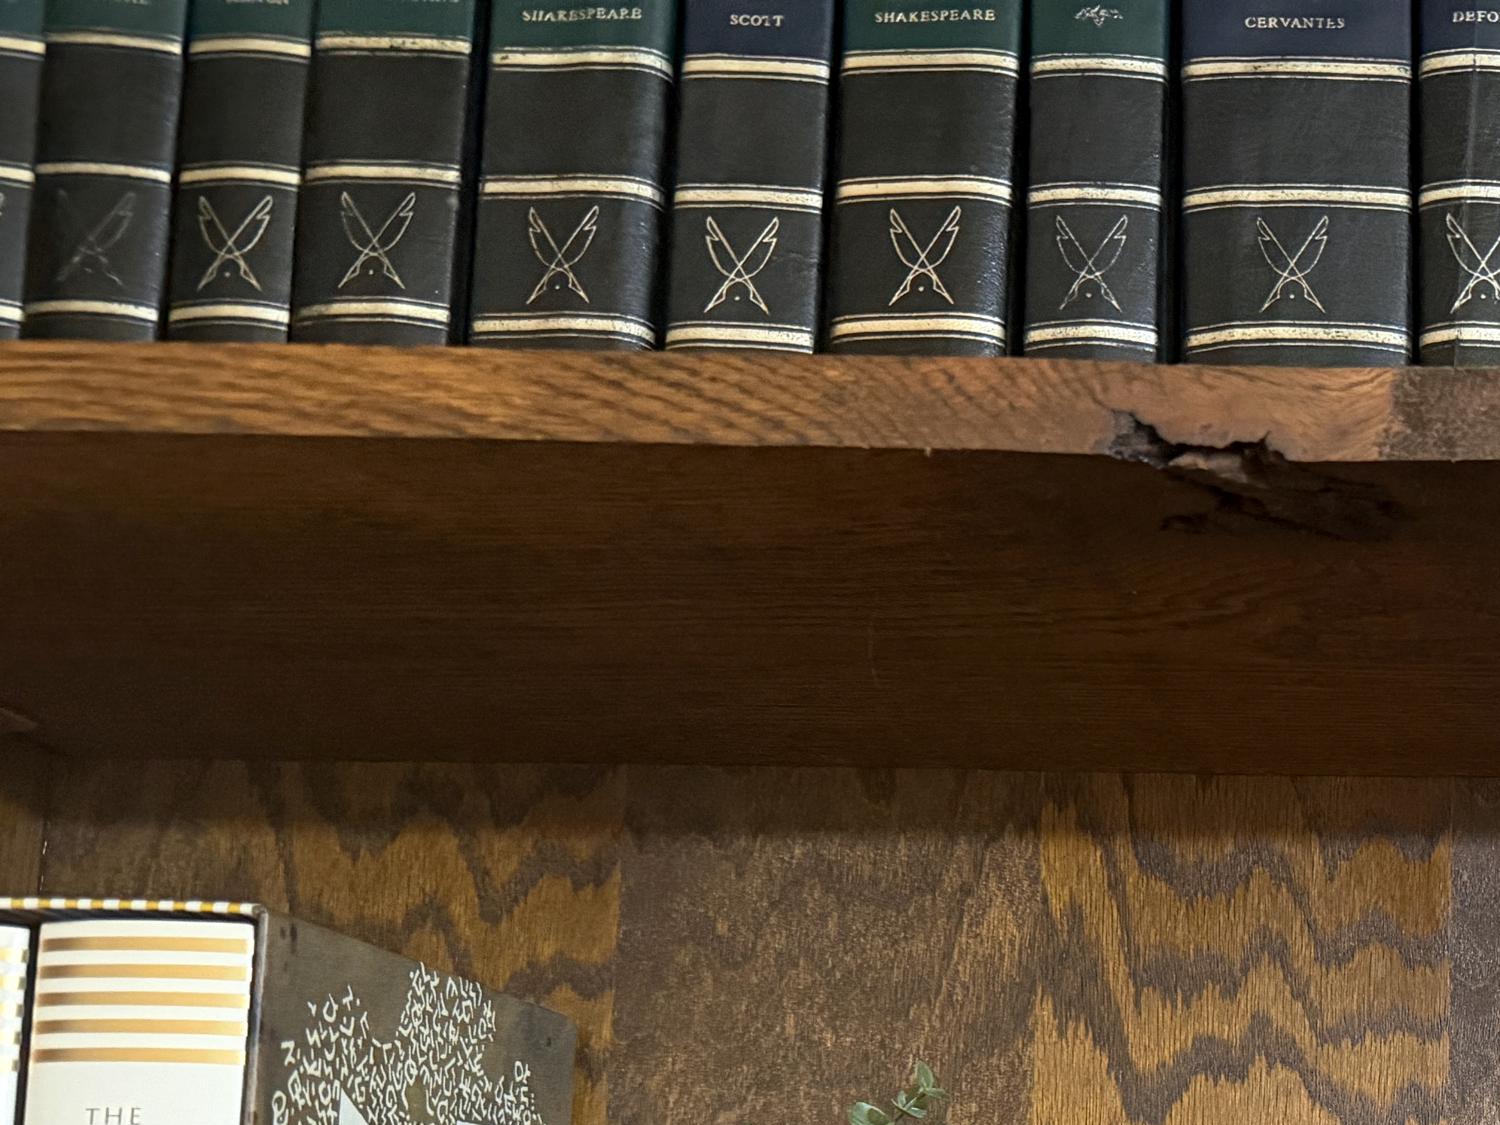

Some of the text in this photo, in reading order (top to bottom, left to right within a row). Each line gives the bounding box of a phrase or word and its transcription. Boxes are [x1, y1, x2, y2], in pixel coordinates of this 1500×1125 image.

[522, 8, 642, 22] SHAKESPEARE
[730, 14, 784, 27] SCOTT
[874, 9, 997, 23] SHAKESPEARE
[1245, 16, 1345, 29] CERVANTES
[86, 1107, 142, 1125] THE
